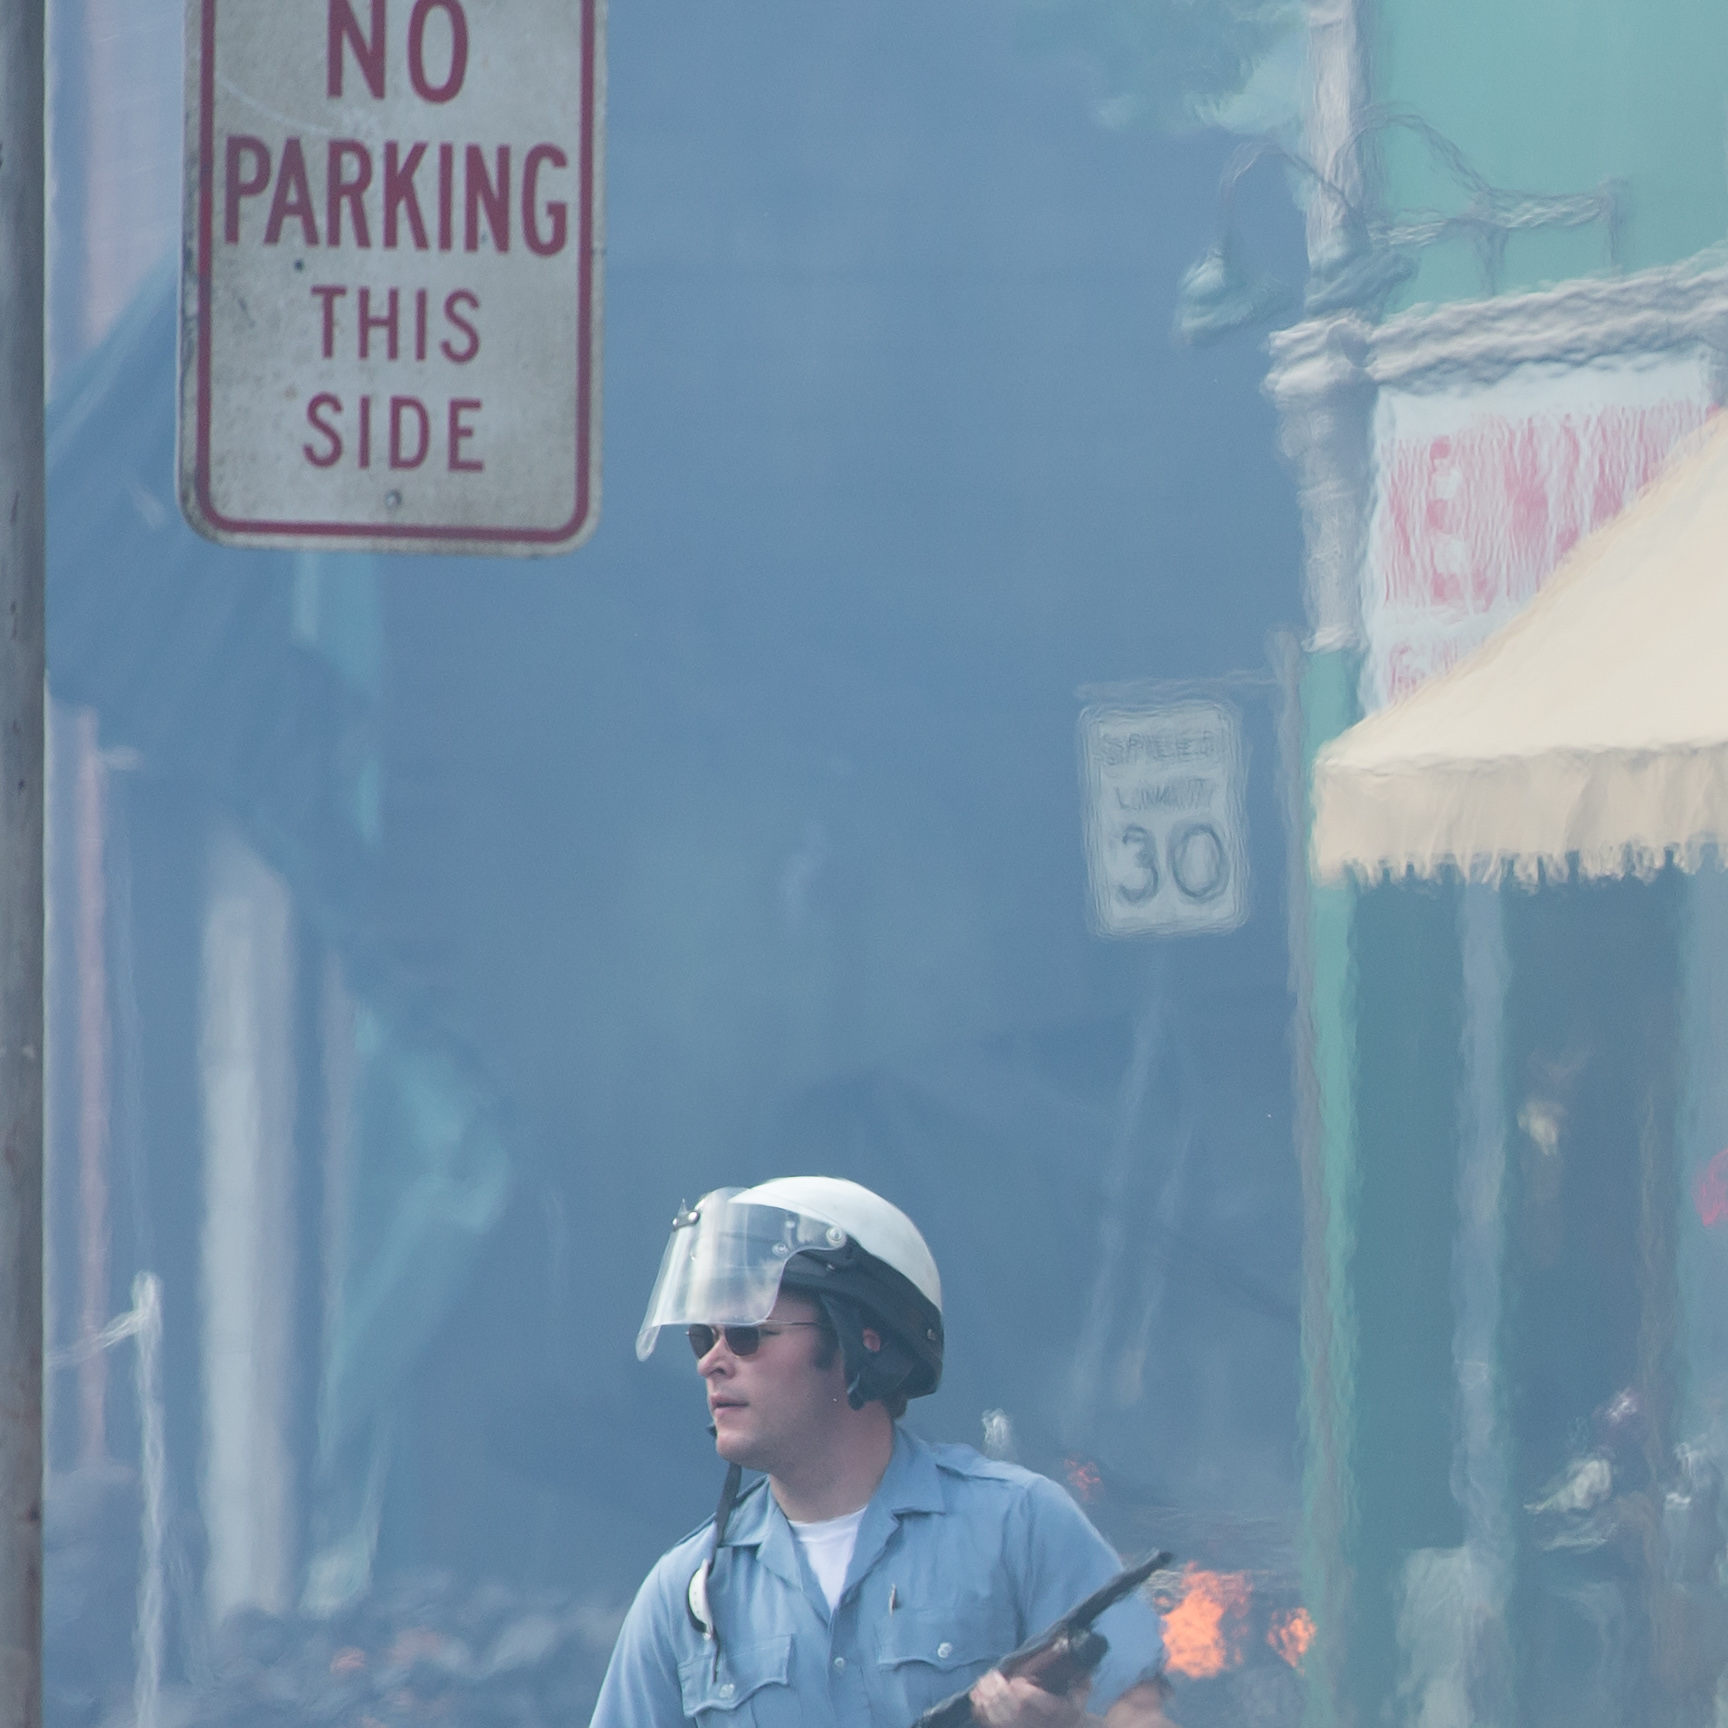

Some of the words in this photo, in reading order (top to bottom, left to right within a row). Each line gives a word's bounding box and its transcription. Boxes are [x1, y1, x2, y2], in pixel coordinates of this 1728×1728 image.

[326, 0, 469, 104] NO
[223, 135, 569, 257] PARKING
[310, 285, 480, 363] THIS
[303, 393, 485, 472] SIDE
[1117, 822, 1230, 903] 30
